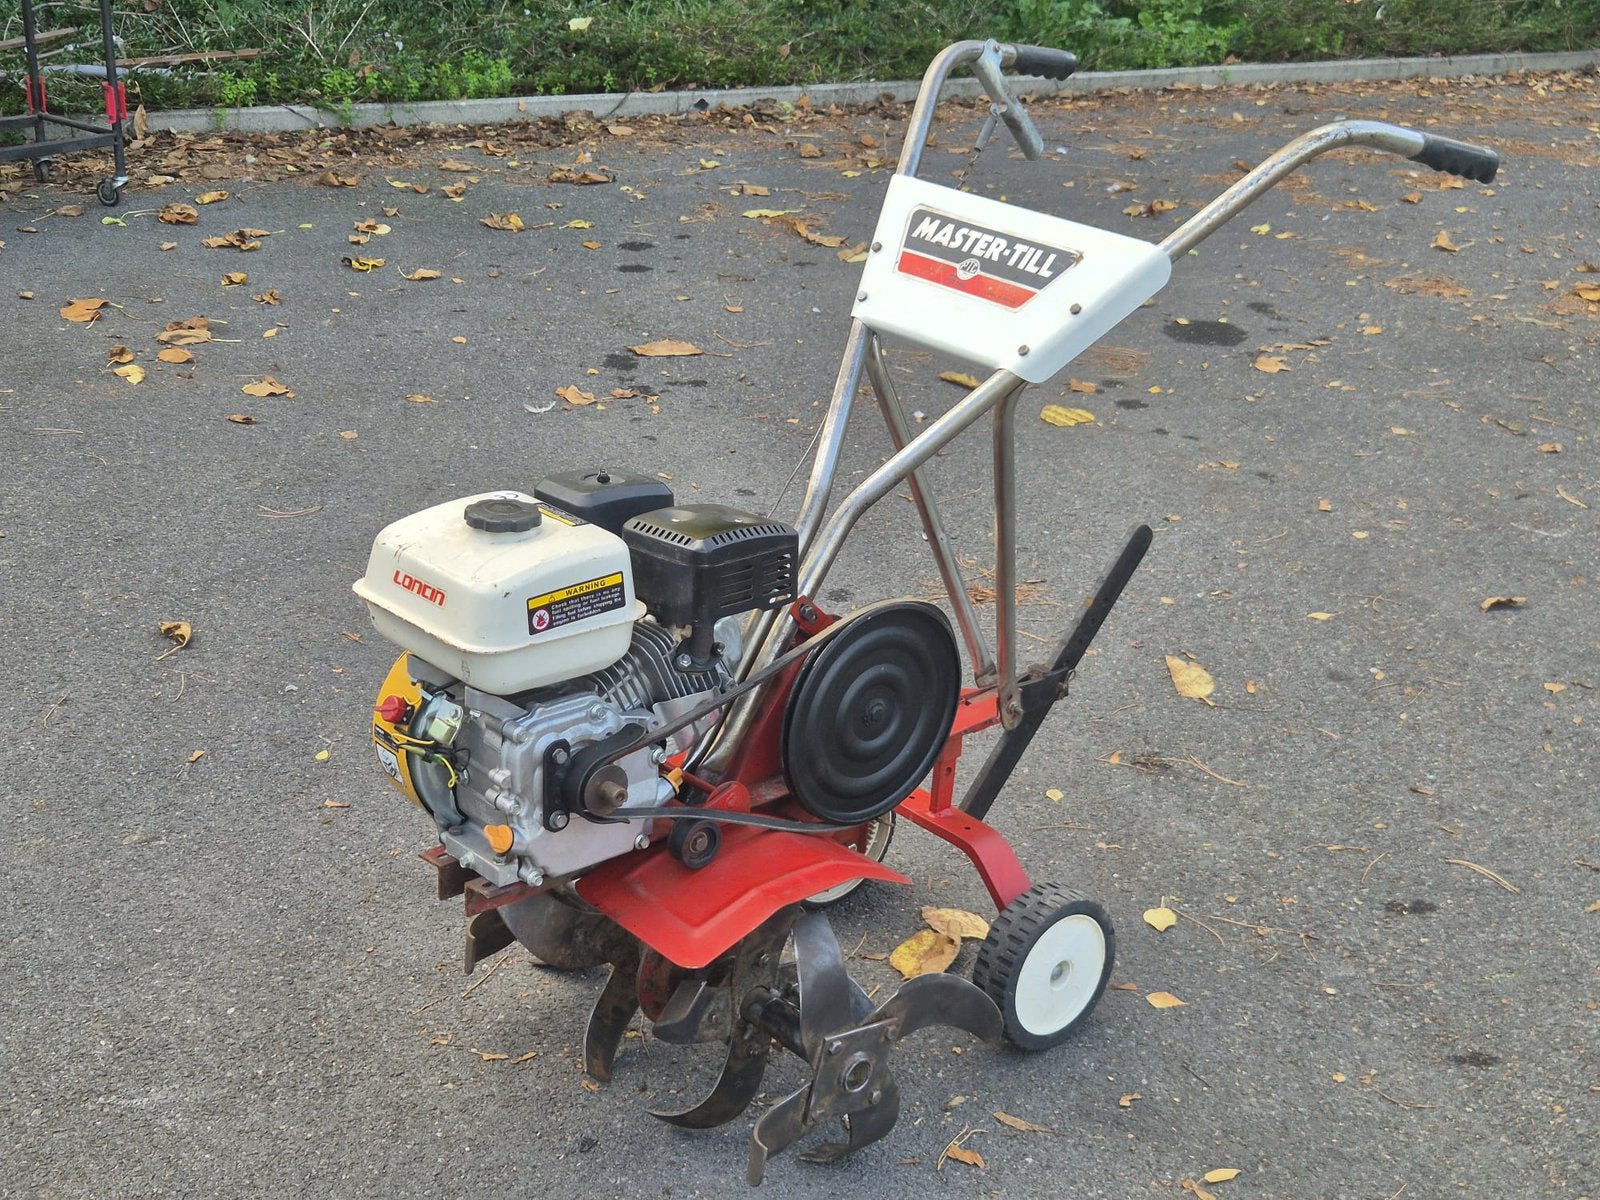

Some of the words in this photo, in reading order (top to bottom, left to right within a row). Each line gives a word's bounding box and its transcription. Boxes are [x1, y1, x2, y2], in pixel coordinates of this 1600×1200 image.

[565, 579, 606, 597] WARNING
[551, 601, 567, 610] Check
[568, 597, 580, 605] that
[580, 593, 595, 601] there
